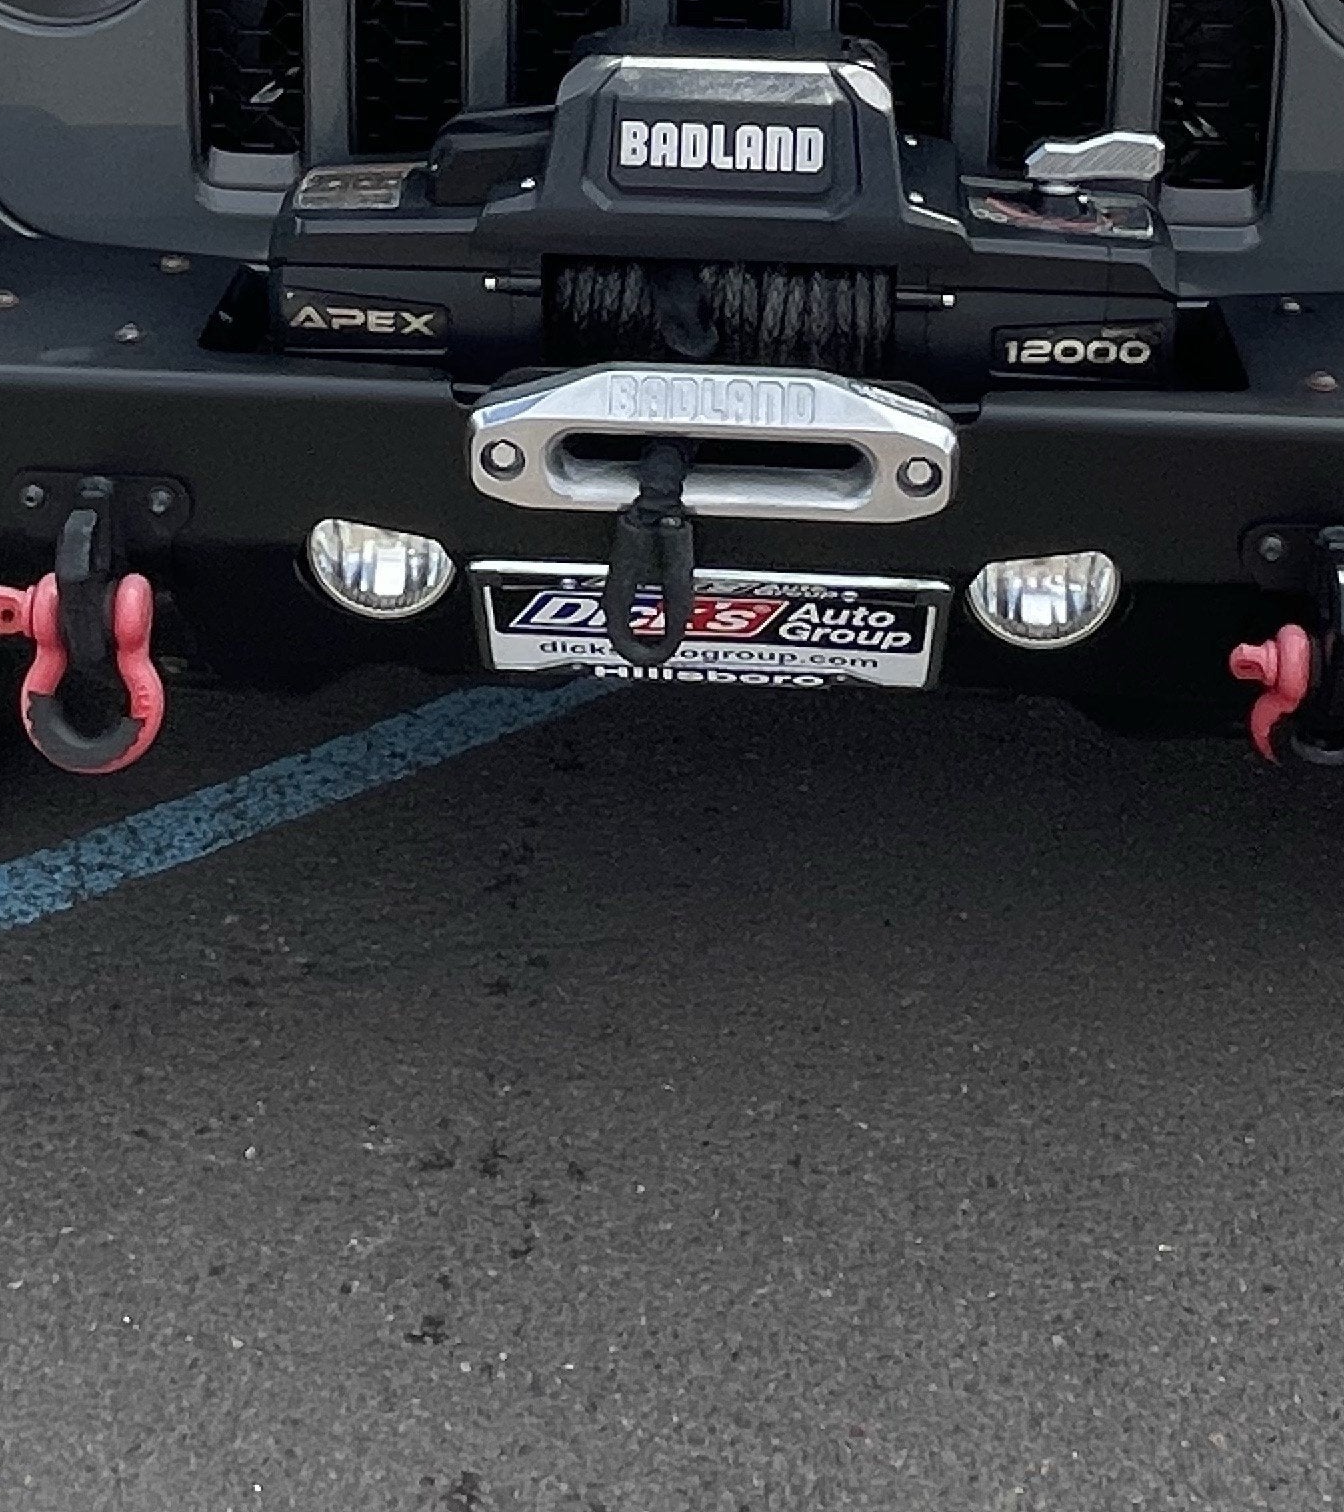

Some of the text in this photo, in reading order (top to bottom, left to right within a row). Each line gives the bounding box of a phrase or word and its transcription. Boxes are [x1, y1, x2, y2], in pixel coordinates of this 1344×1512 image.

[619, 120, 825, 173] BADLAND
[289, 305, 436, 336] APEX
[1004, 339, 1153, 365] 12000
[607, 374, 817, 426] BADLAND
[786, 602, 897, 628] Auto
[778, 620, 913, 651] Group
